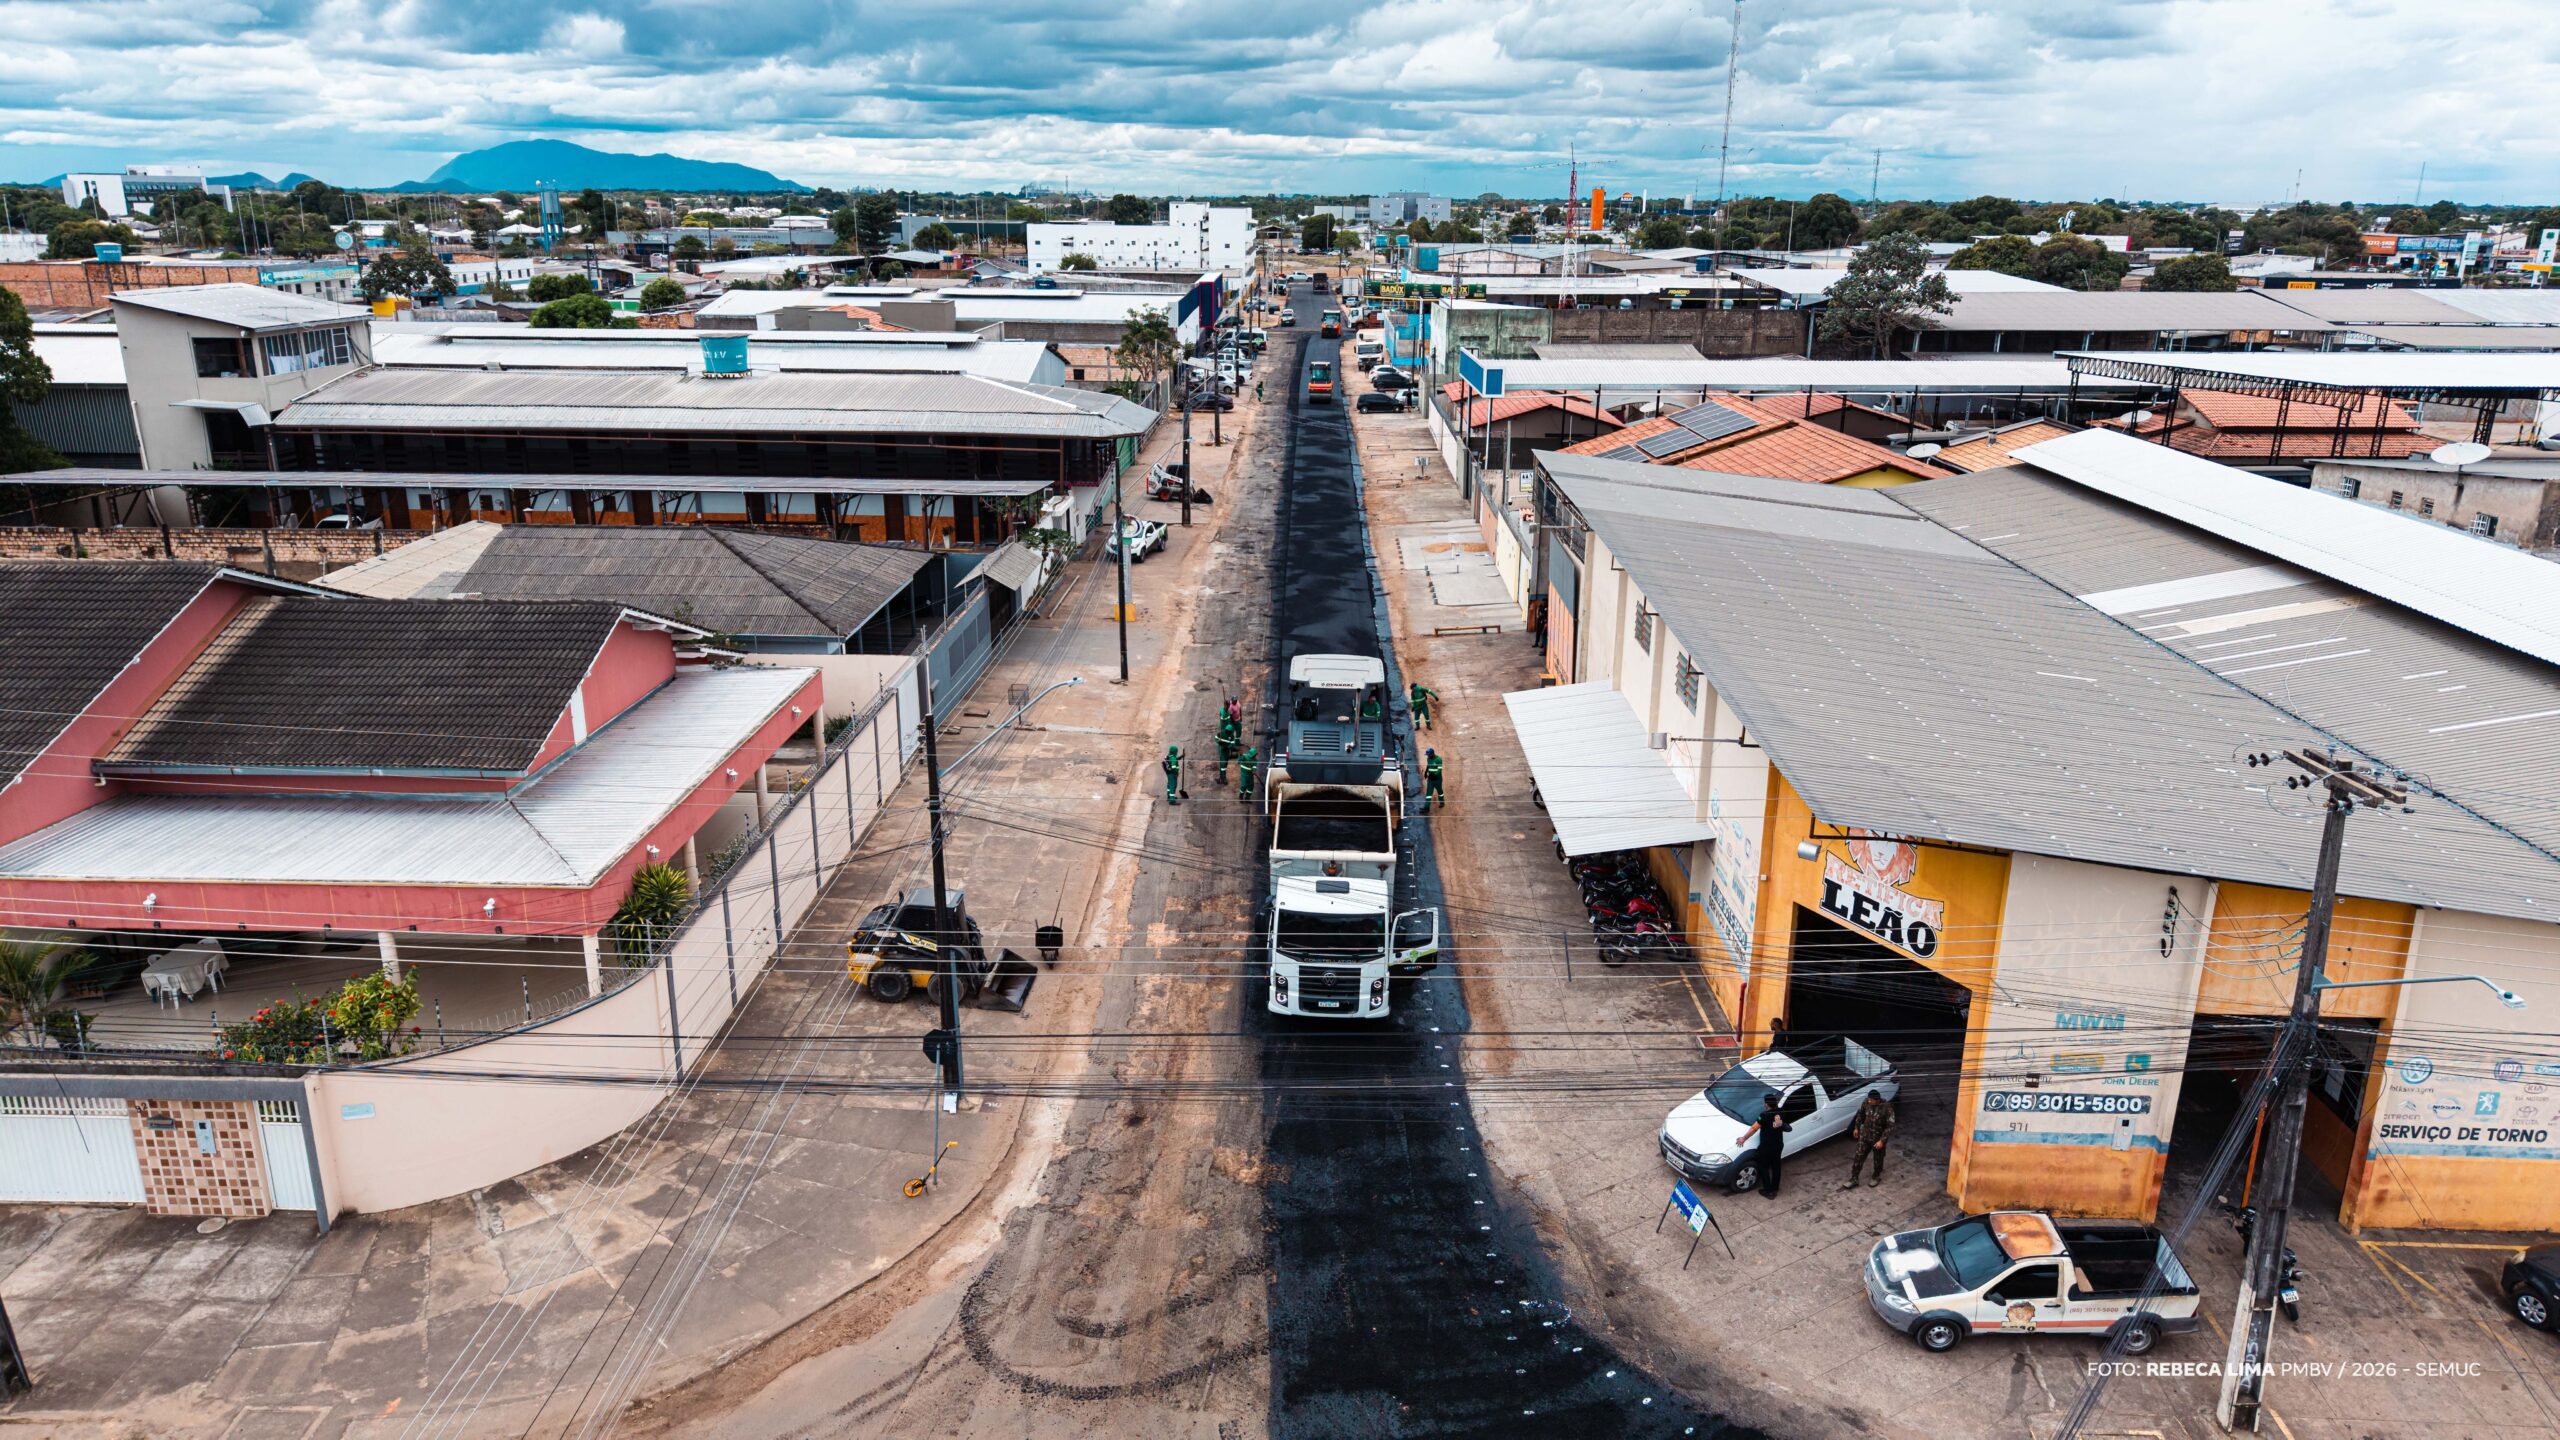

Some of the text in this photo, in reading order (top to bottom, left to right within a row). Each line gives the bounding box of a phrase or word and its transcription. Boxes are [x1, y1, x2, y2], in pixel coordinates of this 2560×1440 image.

[260, 272, 272, 282] HC
[1825, 862, 1944, 930] RETIFICA
[1821, 877, 1937, 957] LEÃO
[2055, 1011, 2124, 1031] MWM
[2500, 1063, 2519, 1077] FIAT
[2101, 1077, 2159, 1086] JOHN DEERE
[2009, 1122, 2028, 1133] 971
[2380, 1124, 2548, 1143] SERVIÇO DE TORNO
